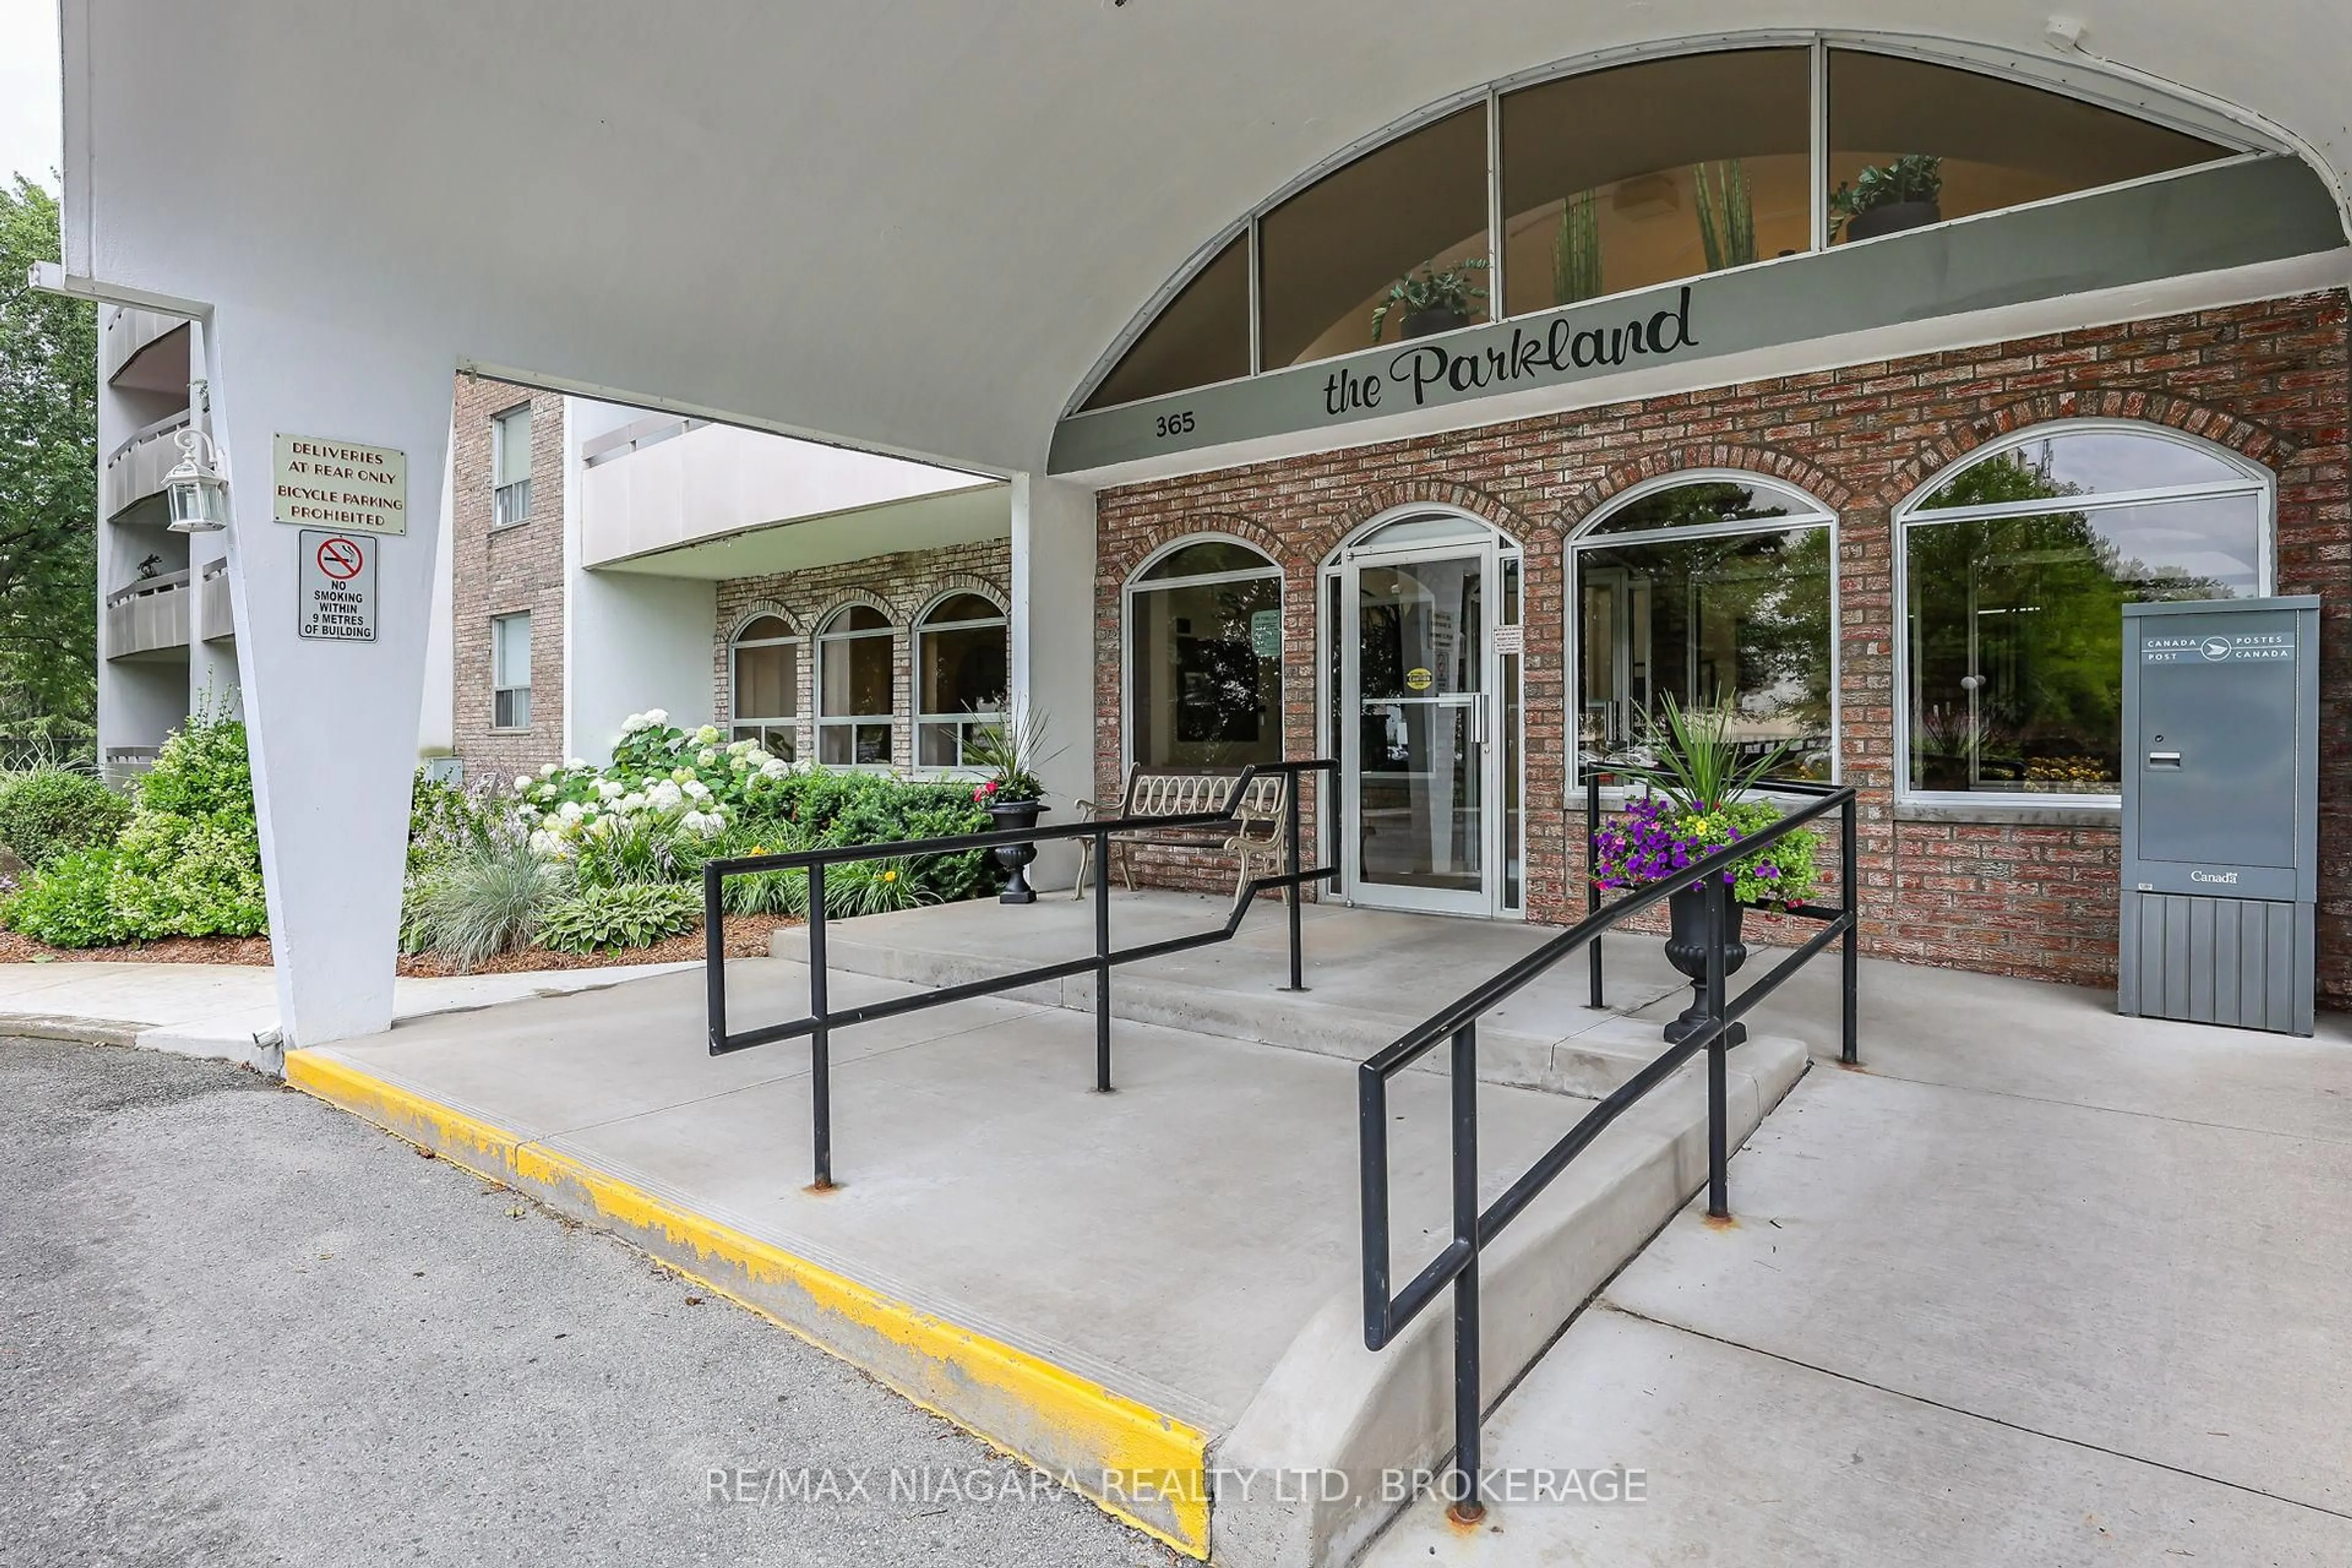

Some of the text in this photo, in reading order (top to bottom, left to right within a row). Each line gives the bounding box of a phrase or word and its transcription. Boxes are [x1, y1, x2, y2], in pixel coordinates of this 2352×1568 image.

[1324, 287, 1699, 415] the Parkland
[1156, 412, 1195, 437] 365
[293, 442, 383, 464] DELIVERIES
[288, 461, 396, 484] AT REAR ONLY
[278, 485, 402, 510] BICYCLE PARKING
[292, 506, 384, 526] PROHIBITED
[332, 581, 346, 590] NO
[314, 590, 363, 603] SMOKING
[320, 603, 357, 614] WITHIN
[313, 614, 363, 625] 9 METRES
[305, 625, 371, 637] OF BUILDING
[2236, 650, 2288, 658] CANADA
[2191, 871, 2237, 884] Canada
